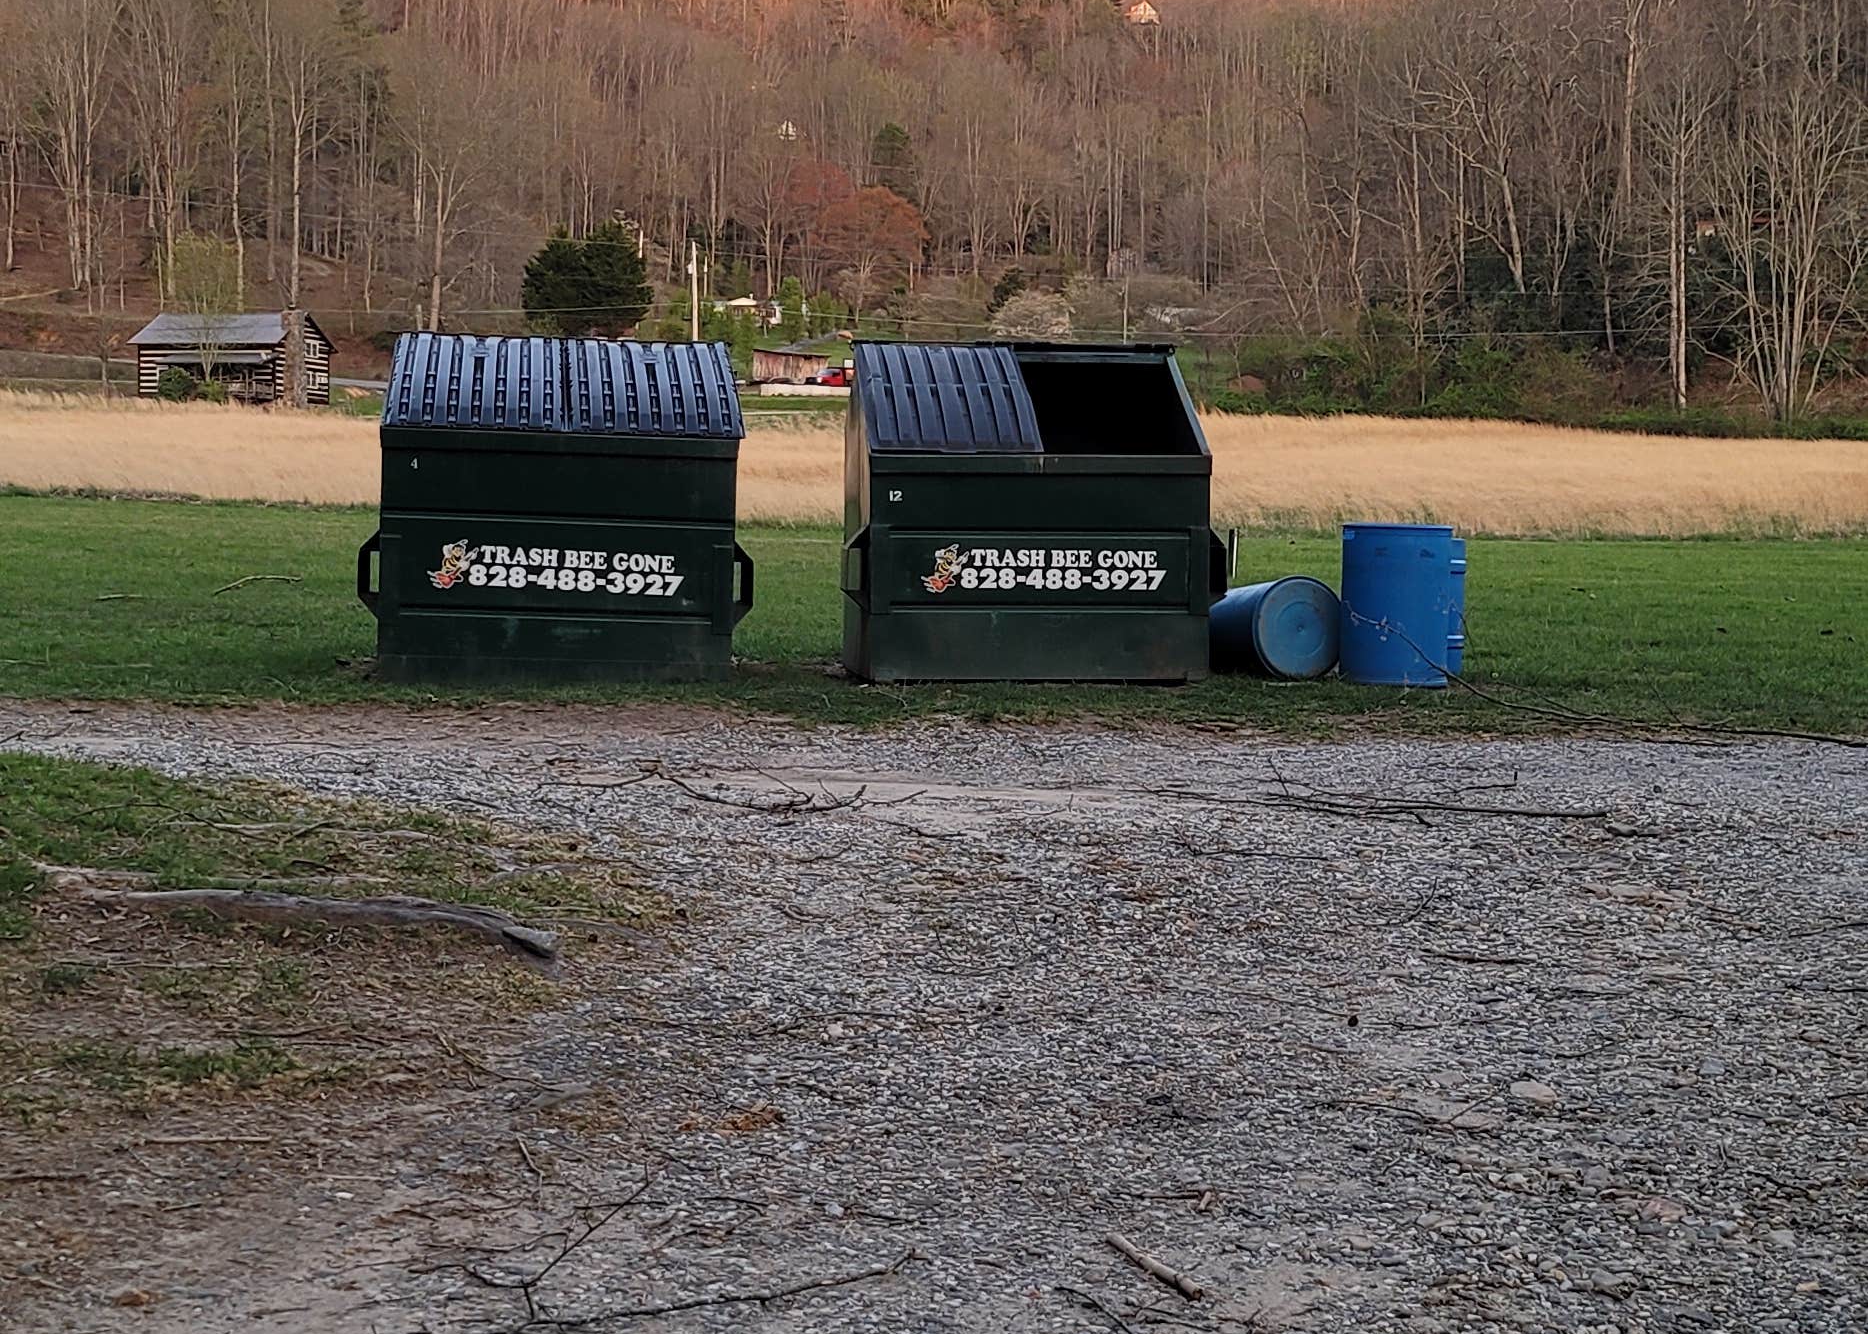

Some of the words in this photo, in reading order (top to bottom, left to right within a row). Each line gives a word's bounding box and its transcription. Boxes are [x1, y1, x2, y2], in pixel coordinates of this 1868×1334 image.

[889, 490, 903, 502] 12
[480, 544, 559, 567] TRASH
[563, 549, 608, 569] BEE
[612, 552, 675, 574] GONE
[970, 548, 1046, 568] TRASH
[1050, 549, 1093, 568] BEE
[1097, 550, 1158, 569] GONE
[468, 563, 685, 597] 828-488-3927
[960, 567, 1167, 591] 828-488-3927
